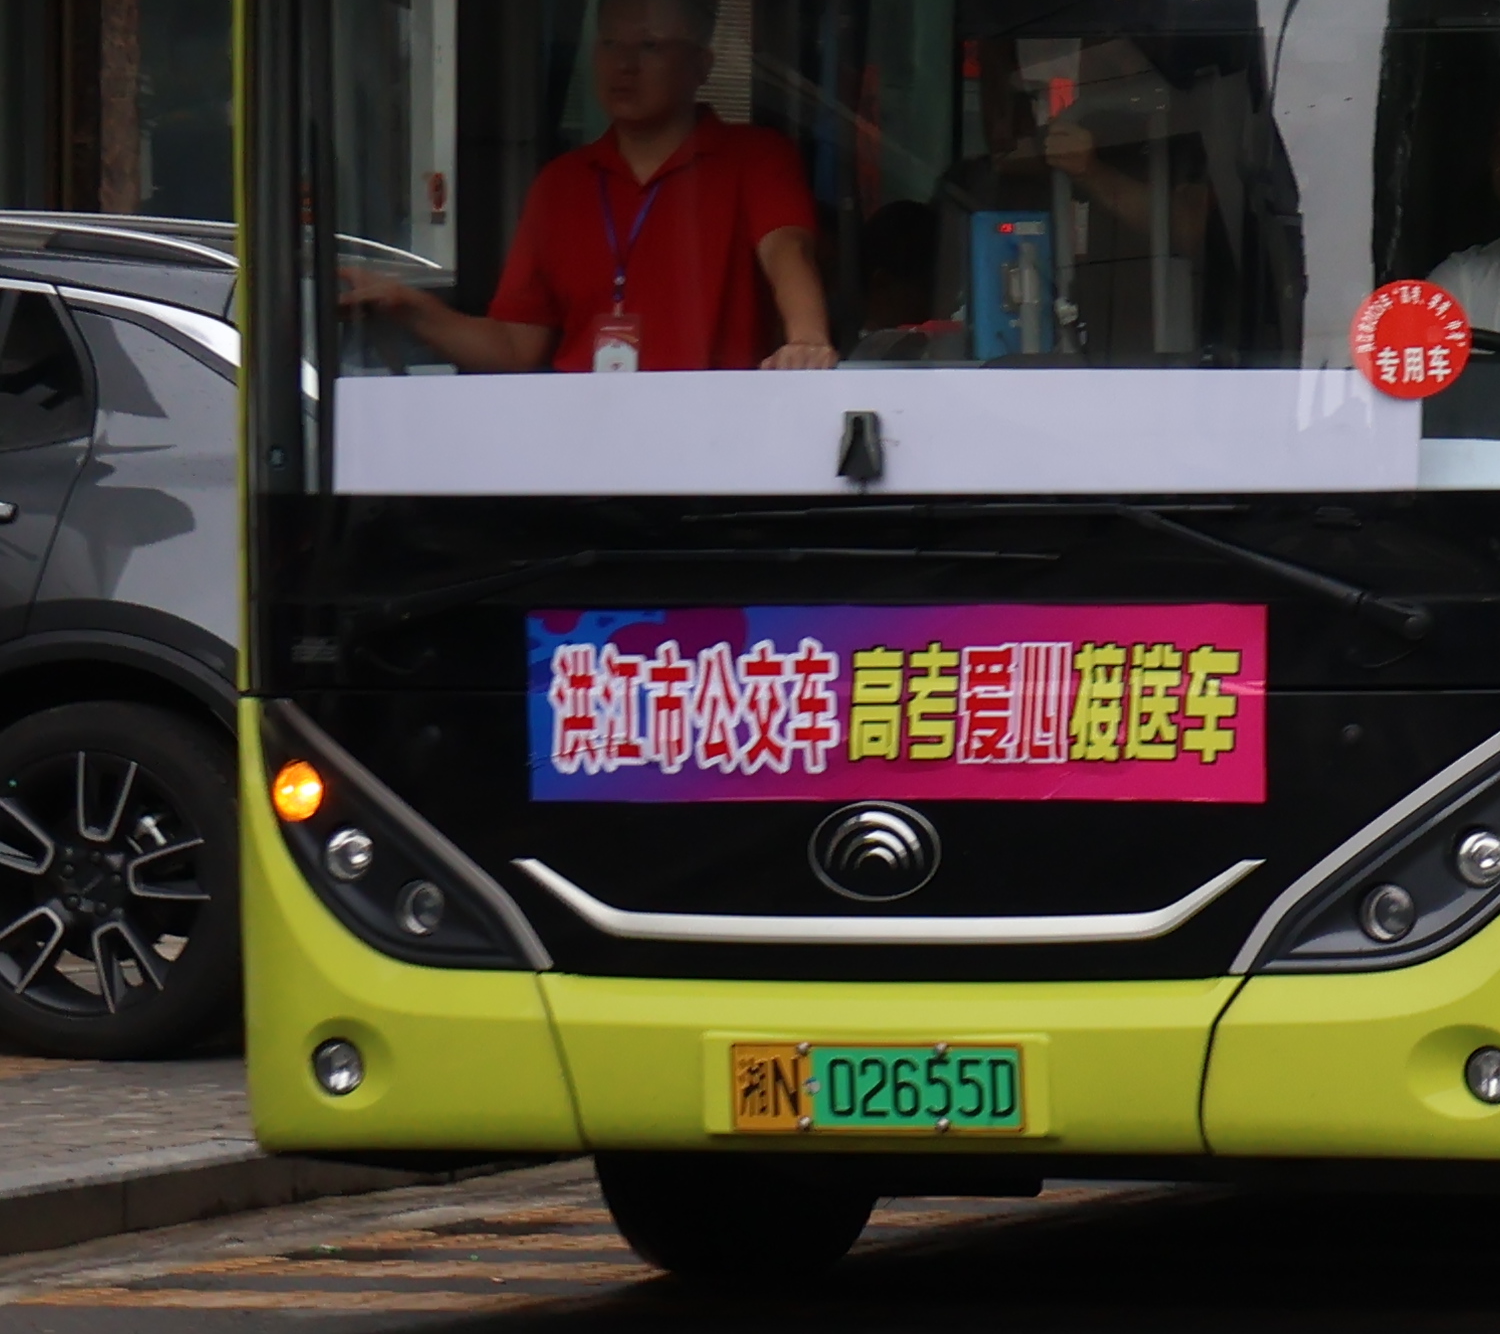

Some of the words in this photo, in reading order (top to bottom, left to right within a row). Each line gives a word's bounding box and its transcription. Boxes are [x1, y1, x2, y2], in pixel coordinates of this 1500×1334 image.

[1375, 346, 1452, 385] 专用车
[827, 1057, 1018, 1119] 02655D
